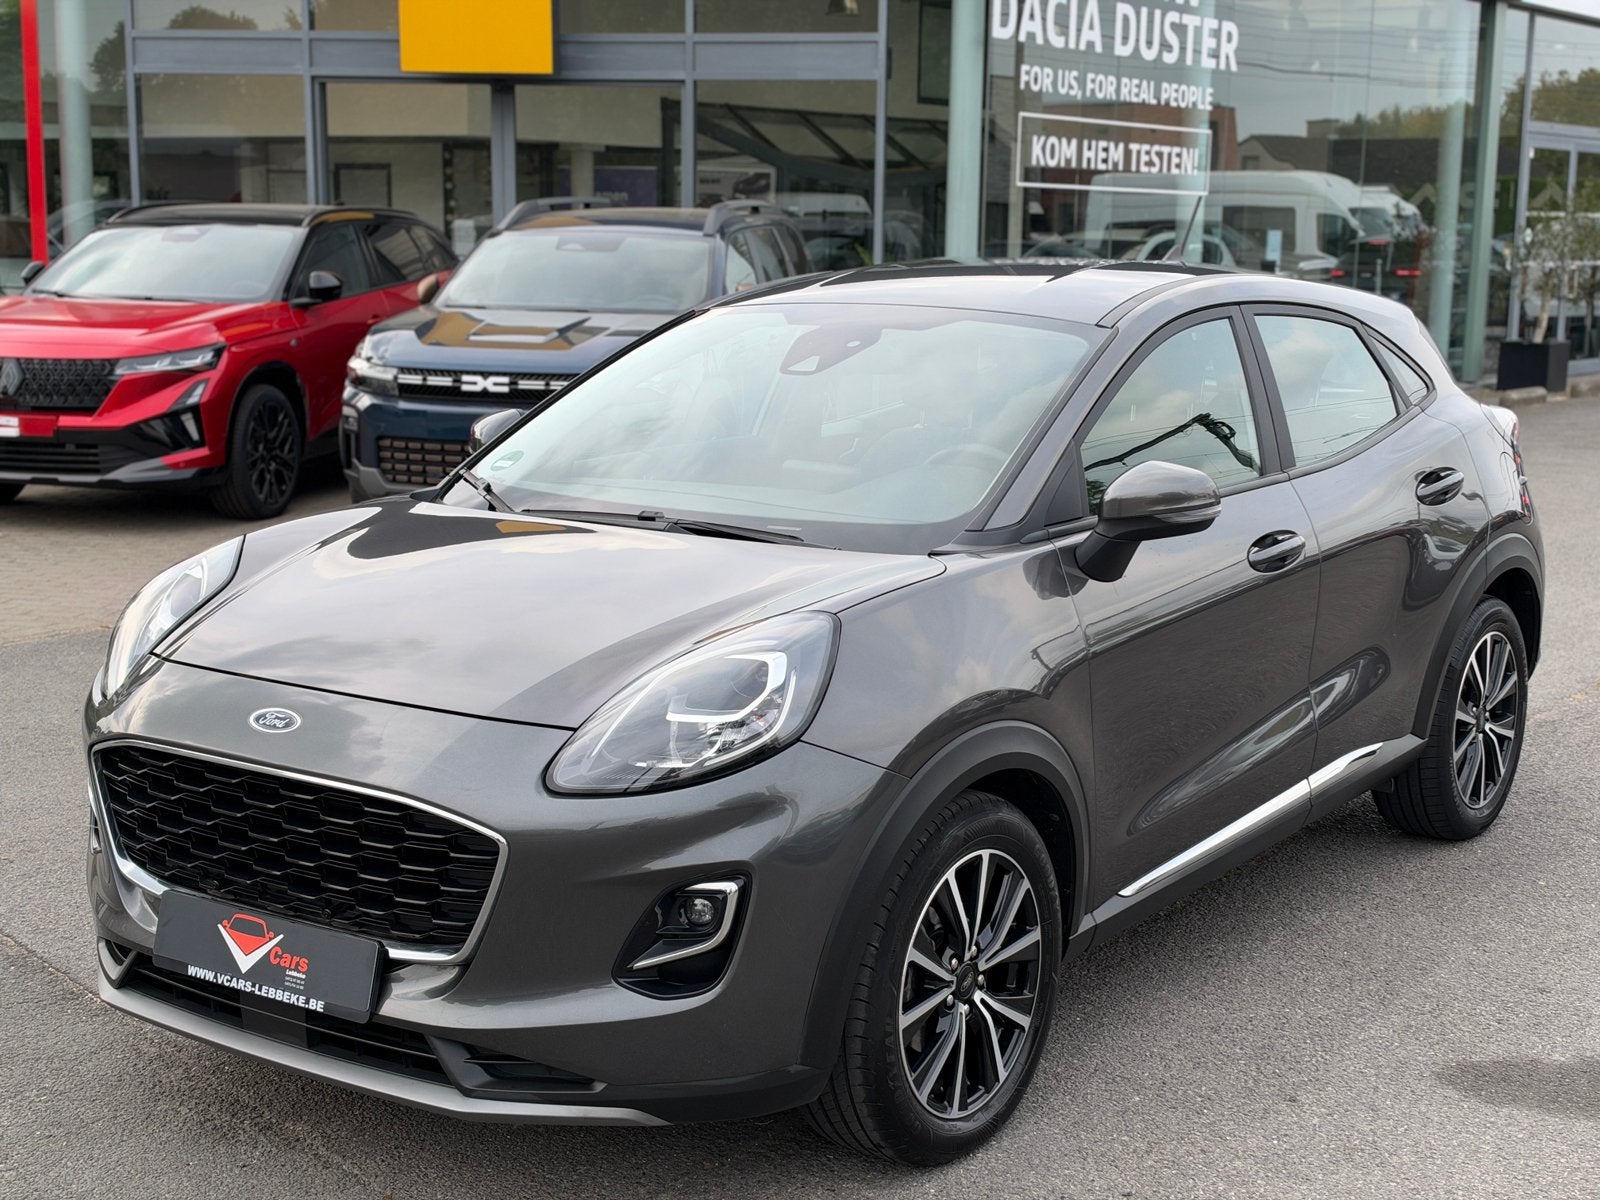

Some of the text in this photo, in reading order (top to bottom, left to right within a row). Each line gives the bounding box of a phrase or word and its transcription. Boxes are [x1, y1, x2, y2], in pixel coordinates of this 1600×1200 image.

[991, 0, 1239, 72] DACIA DUSTER
[1019, 64, 1214, 111] FOR US, FOR REAL PEOPLE
[1031, 134, 1199, 176] KOM HEM TESTEN!
[269, 946, 309, 973] Cars
[187, 964, 325, 1012] WWW.VCARS-LEBBEKE.BE
